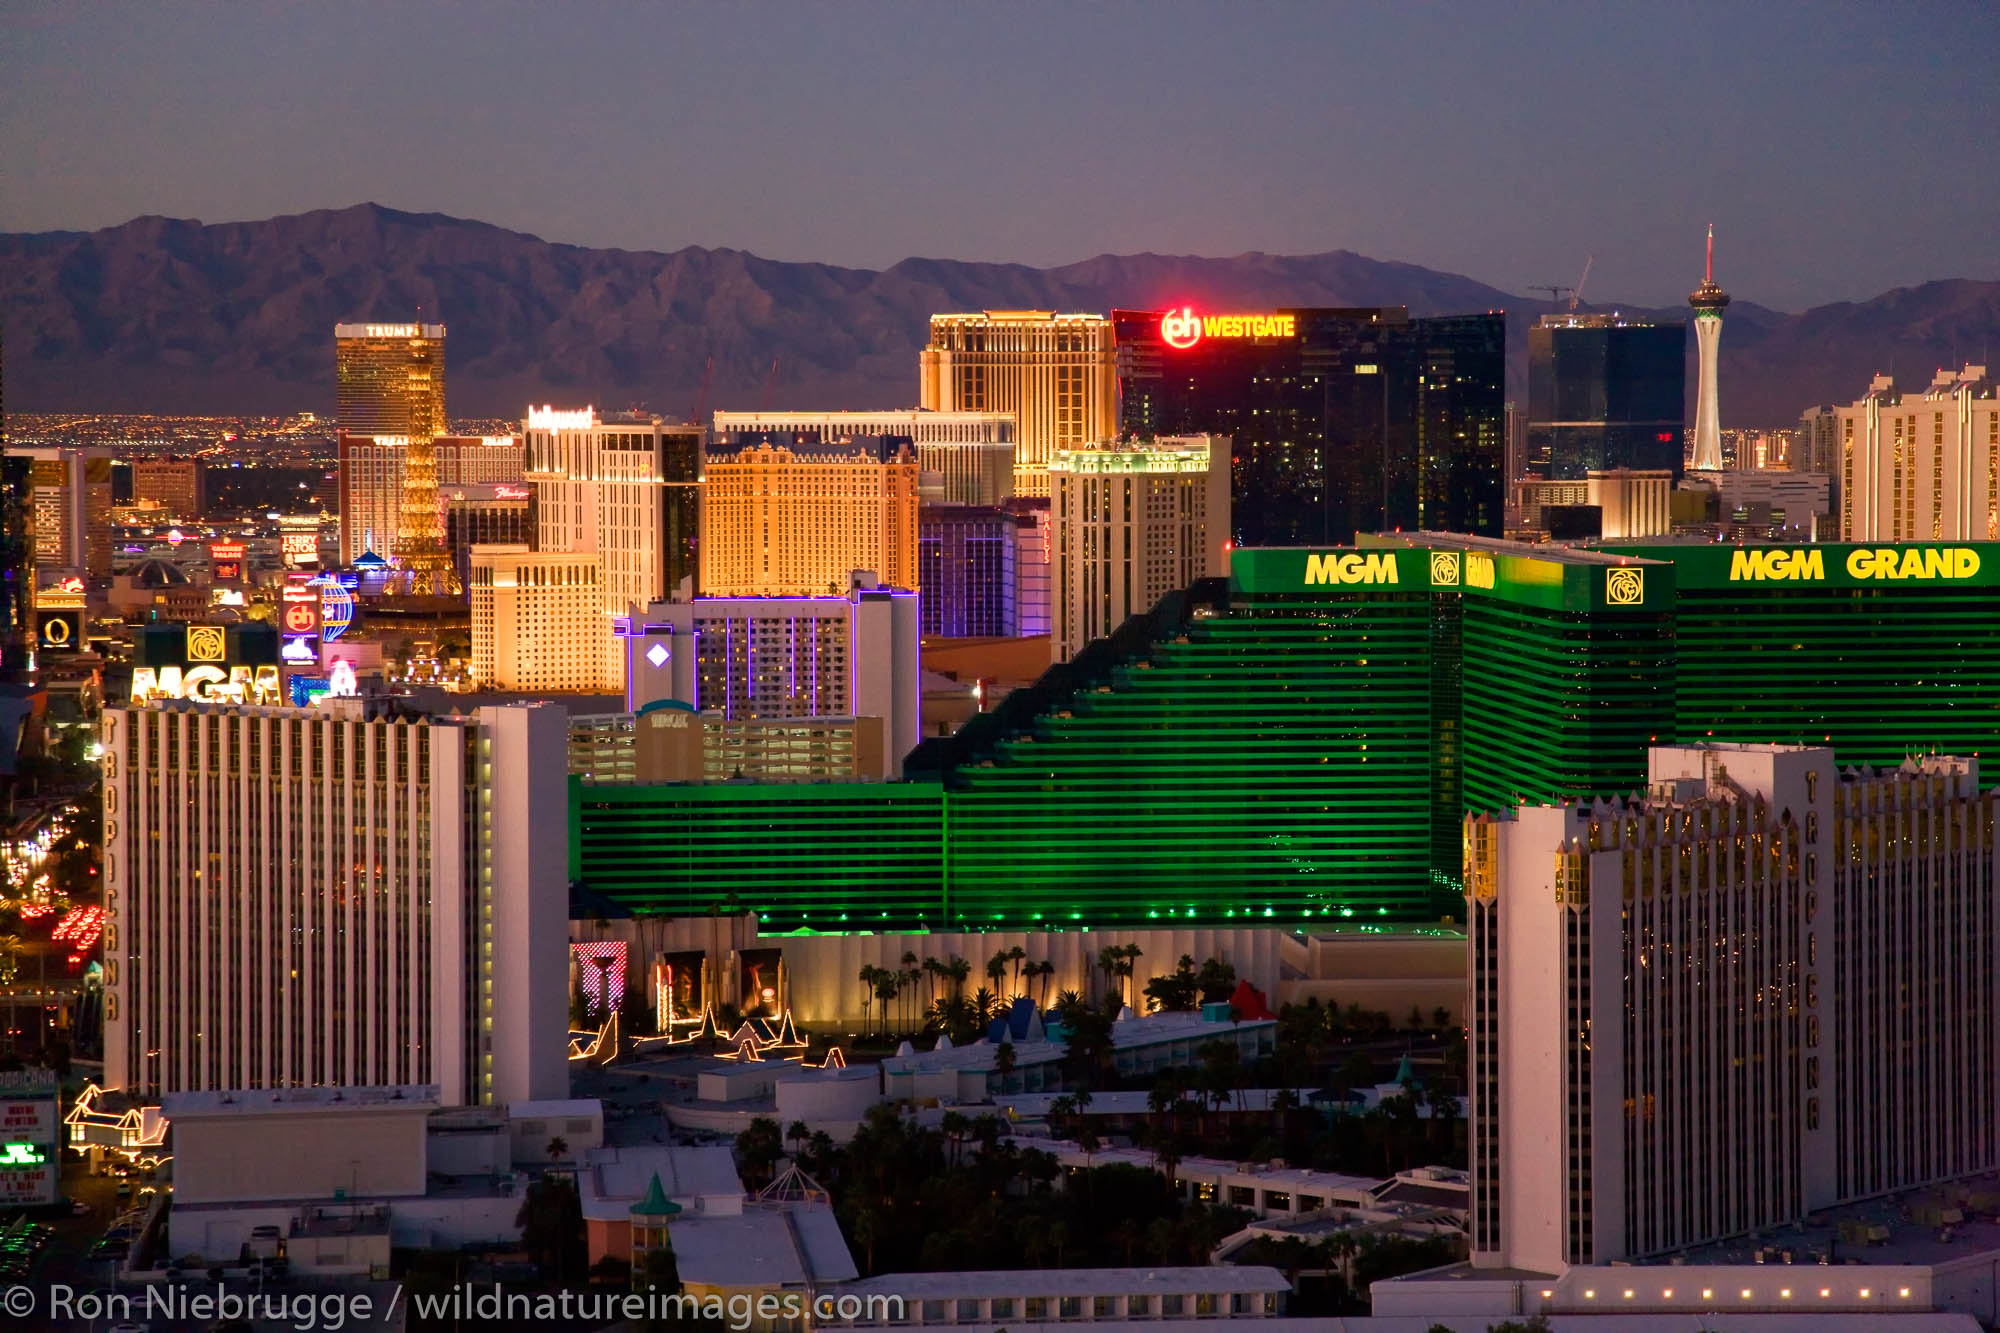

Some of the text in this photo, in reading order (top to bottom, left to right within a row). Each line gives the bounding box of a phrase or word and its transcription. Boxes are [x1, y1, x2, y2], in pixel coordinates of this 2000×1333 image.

[366, 326, 414, 337] TRUMP
[1203, 315, 1295, 337] WESTGATE
[281, 535, 317, 544] TERRY
[282, 544, 317, 552] FATOR
[1304, 554, 1399, 585] MGM
[1730, 549, 1980, 580] MGM GRAND
[130, 665, 283, 707] MGM
[103, 715, 120, 1022] TROPICANA
[1805, 769, 1822, 1131] TROPICANA
